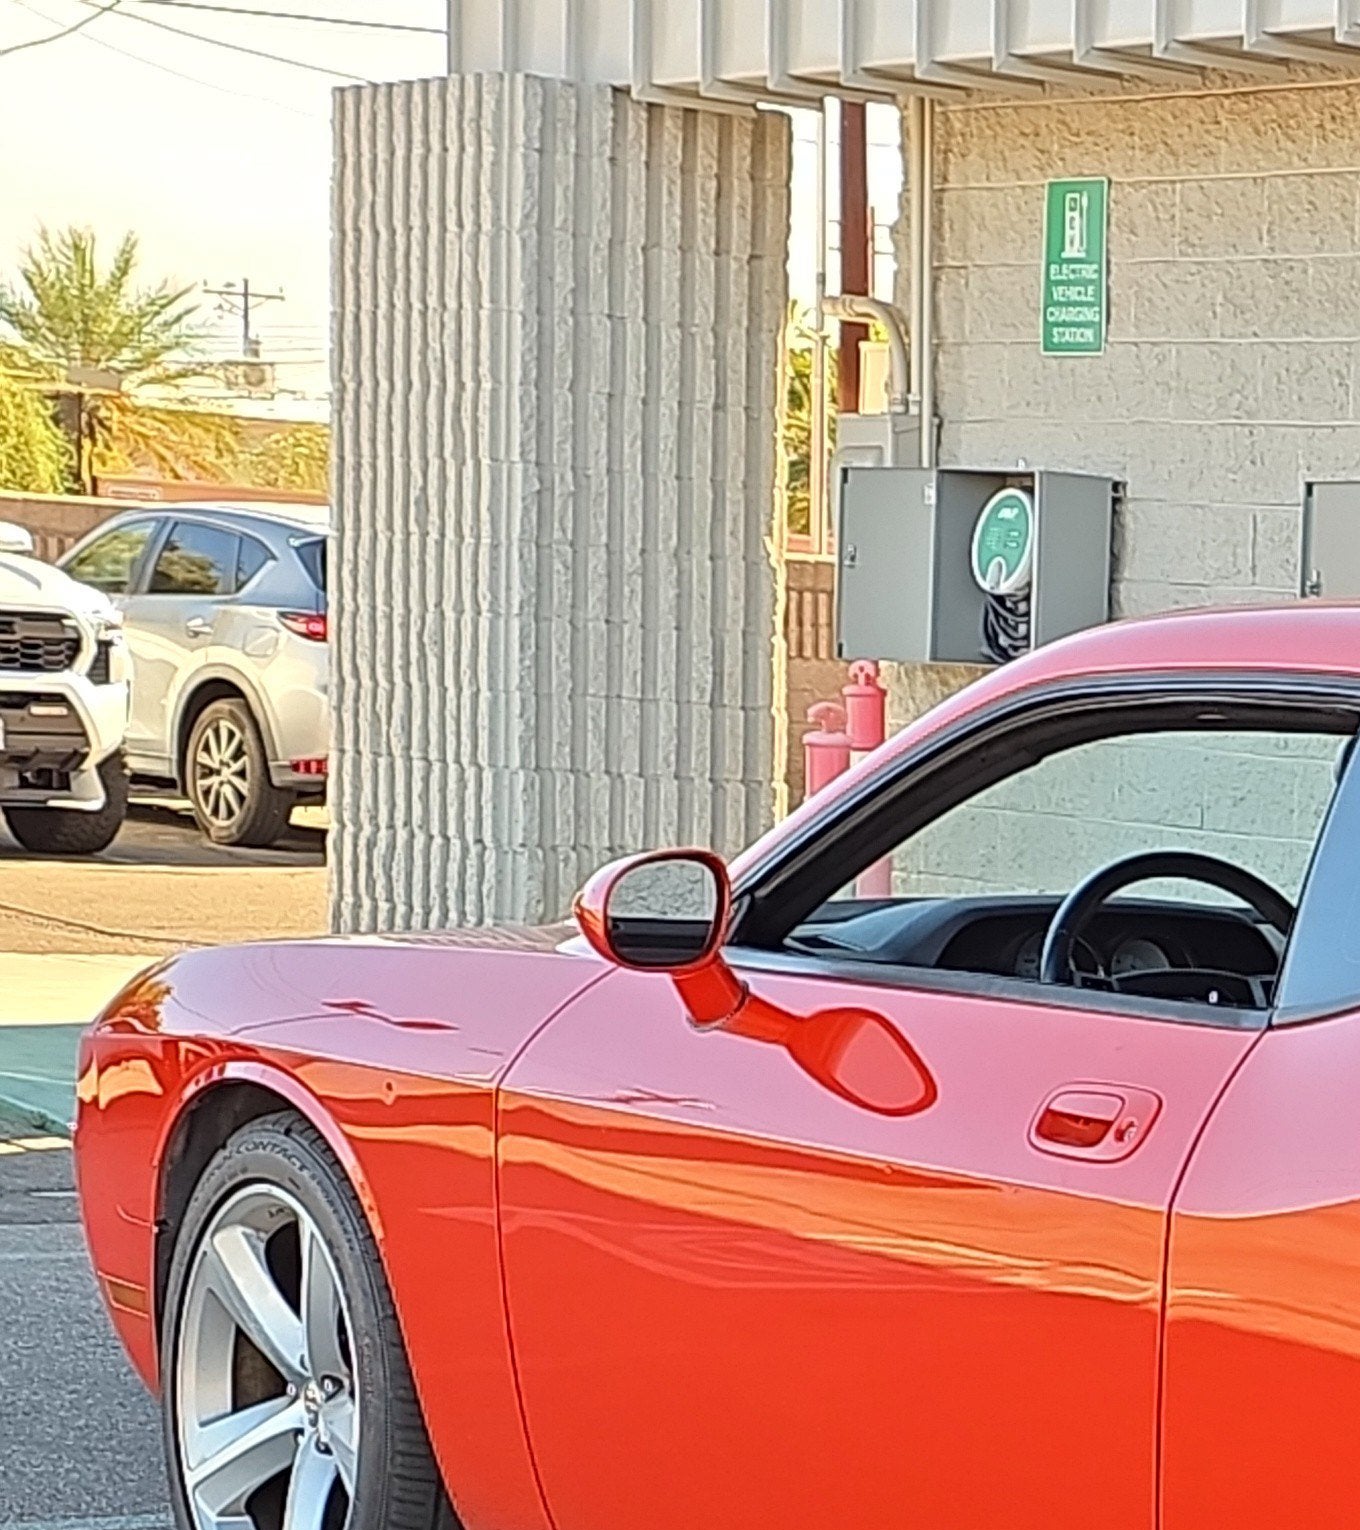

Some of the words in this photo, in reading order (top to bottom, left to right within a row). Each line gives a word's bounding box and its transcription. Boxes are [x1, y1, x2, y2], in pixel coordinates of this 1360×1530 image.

[1050, 263, 1099, 280] ELECTRIC
[1052, 285, 1096, 302] VEHICLE
[1046, 306, 1100, 323] CHARGING
[1052, 326, 1095, 344] STATION
